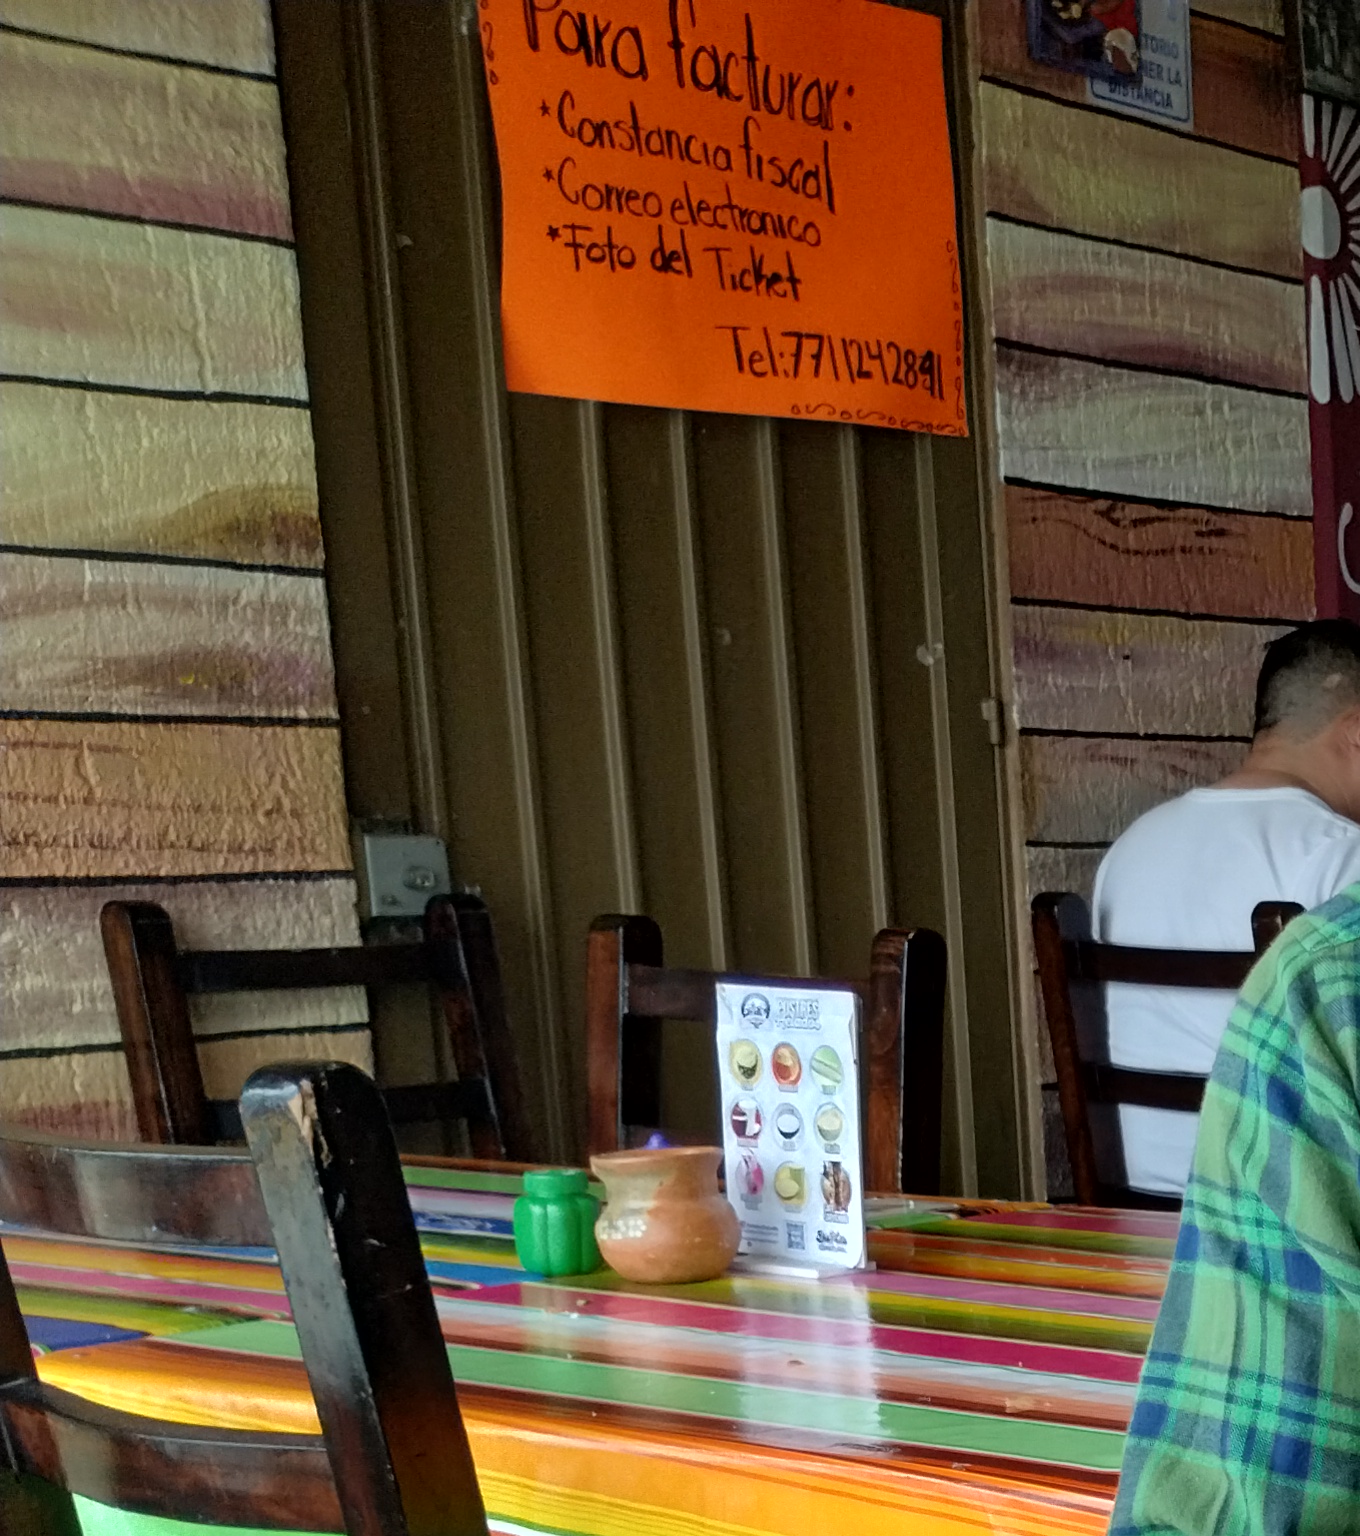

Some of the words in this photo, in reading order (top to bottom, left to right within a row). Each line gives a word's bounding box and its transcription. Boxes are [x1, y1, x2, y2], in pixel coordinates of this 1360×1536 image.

[522, 0, 649, 82] Para
[557, 90, 732, 173] Constancia
[738, 116, 837, 216] fiscal
[557, 156, 663, 219] Correo
[670, 181, 823, 248] electronico
[562, 223, 637, 272] Foto
[650, 225, 693, 279] del
[703, 245, 803, 302] Ticket
